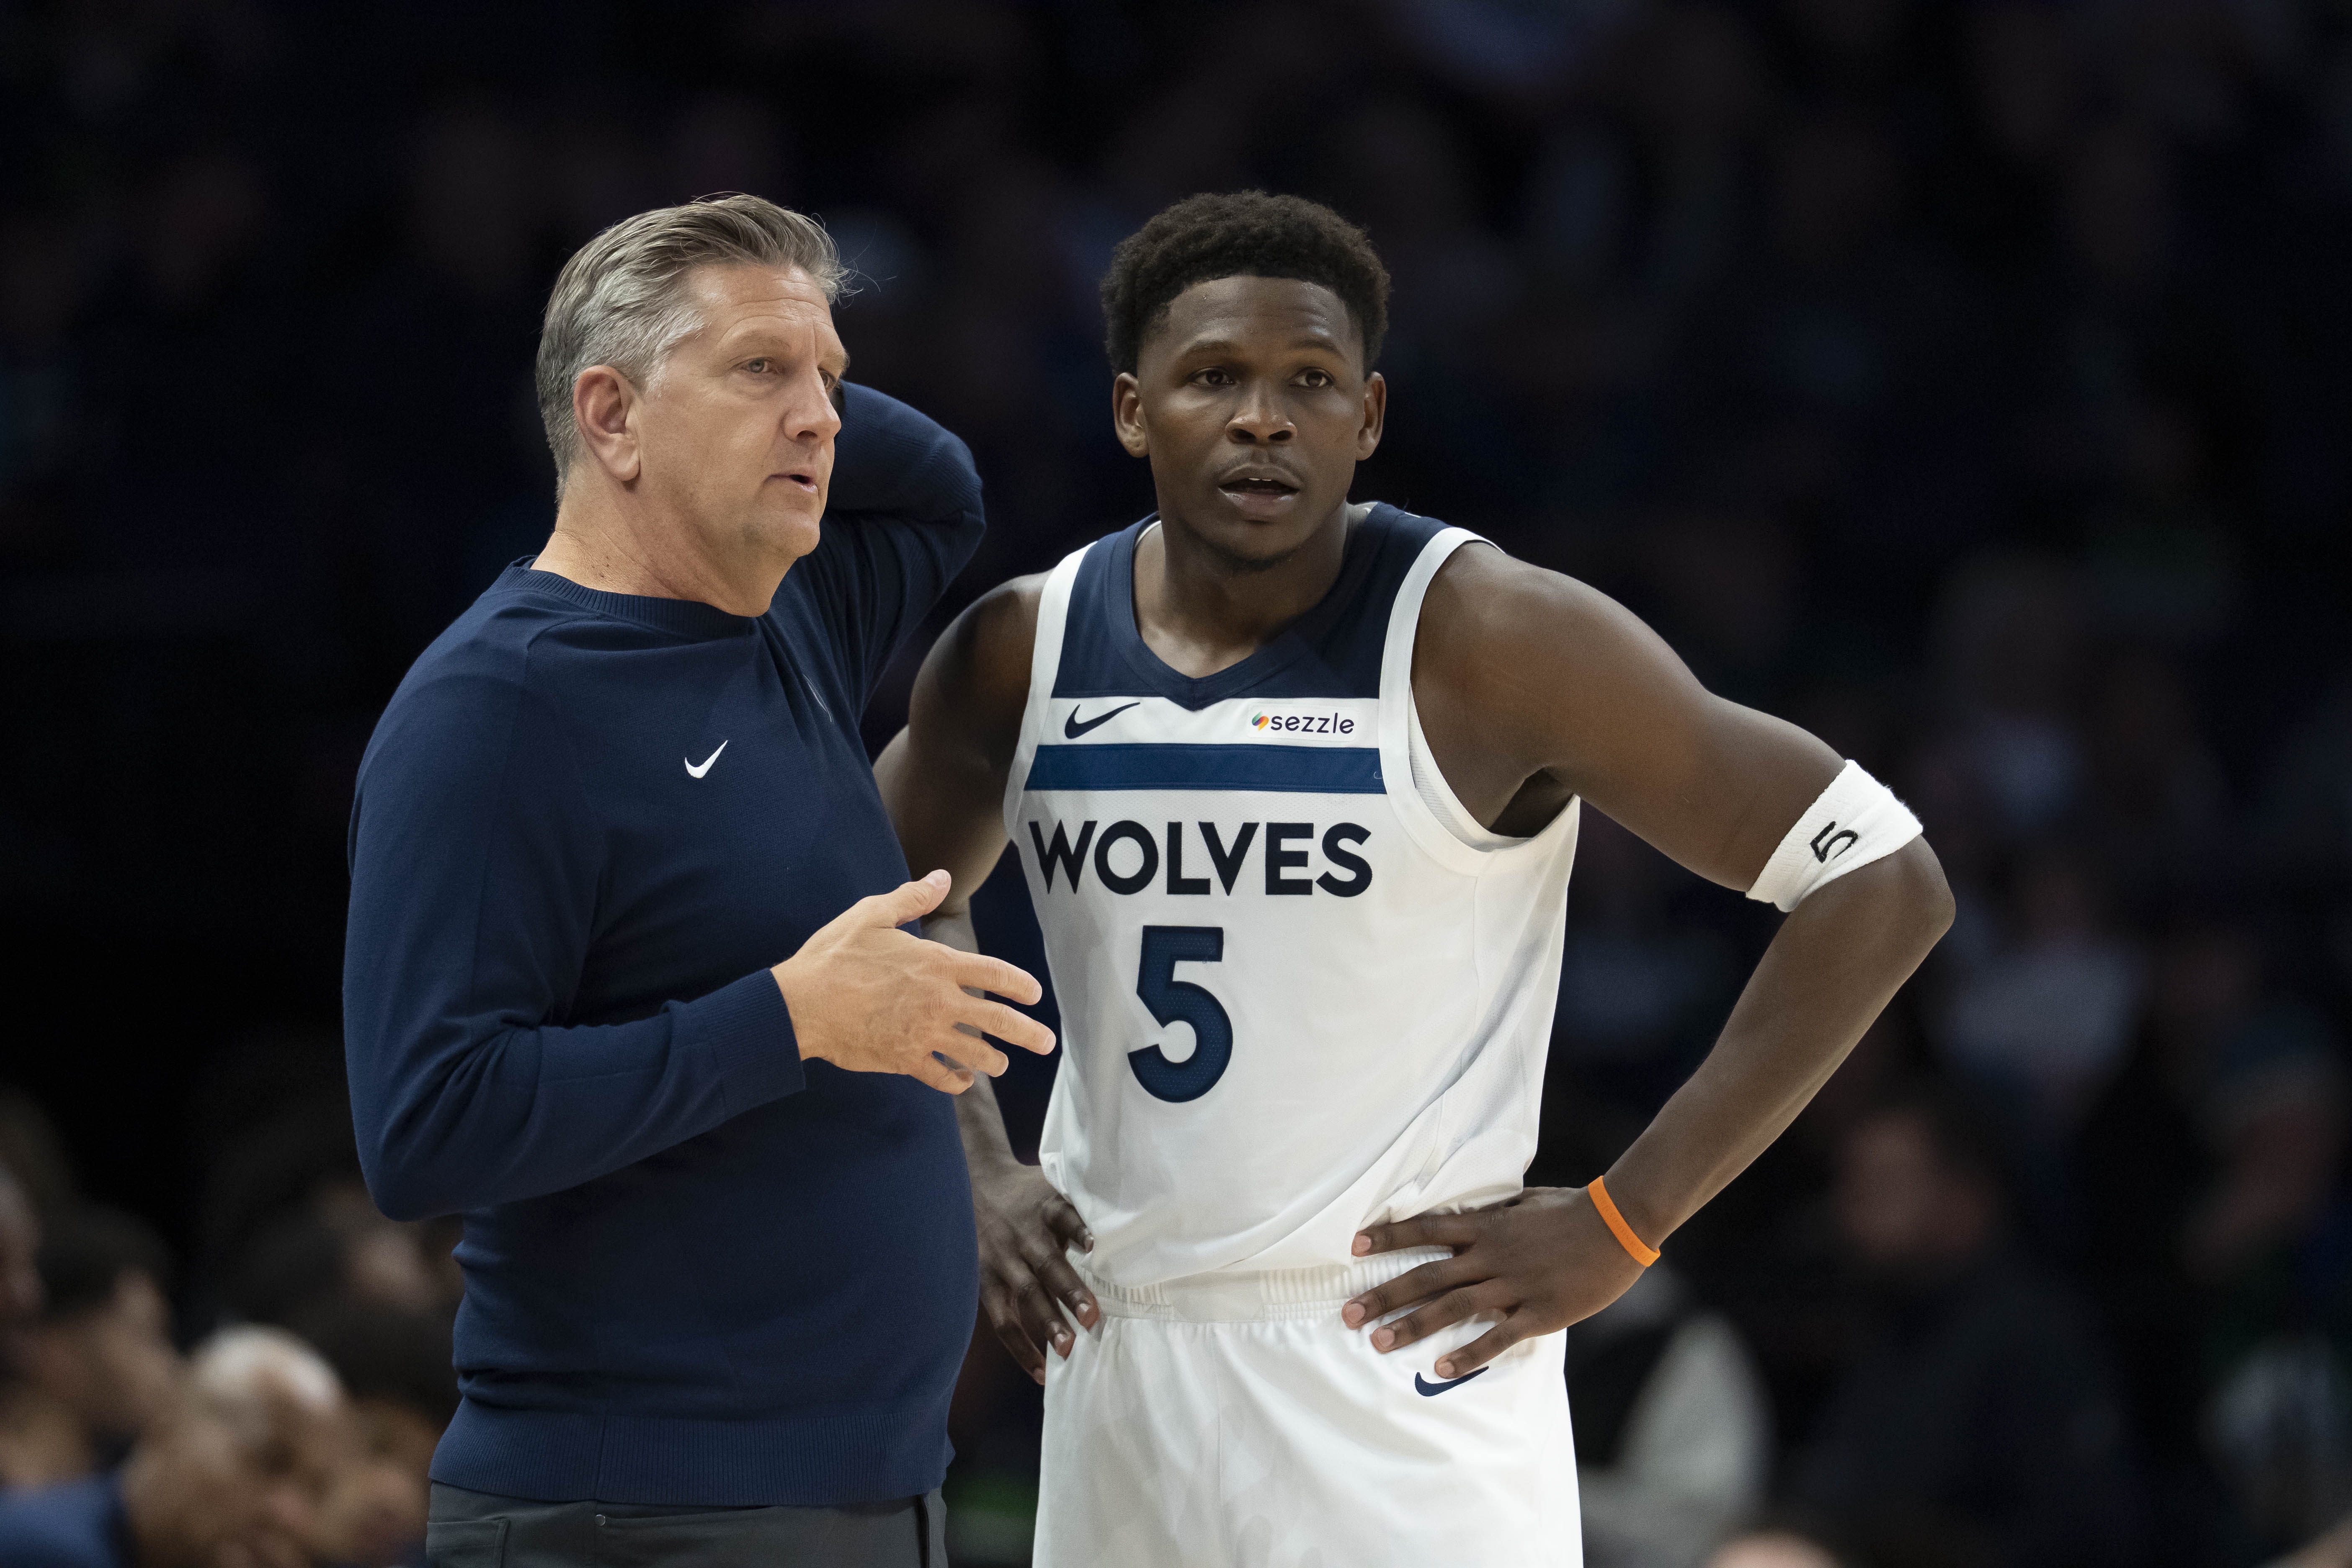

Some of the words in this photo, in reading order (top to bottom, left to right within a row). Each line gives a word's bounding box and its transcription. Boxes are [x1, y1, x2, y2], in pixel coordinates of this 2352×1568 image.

[1271, 712, 1354, 734] sezzle
[1029, 820, 1372, 897] WOLVES
[1810, 821, 1858, 864] 5
[1127, 926, 1233, 1103] 5
